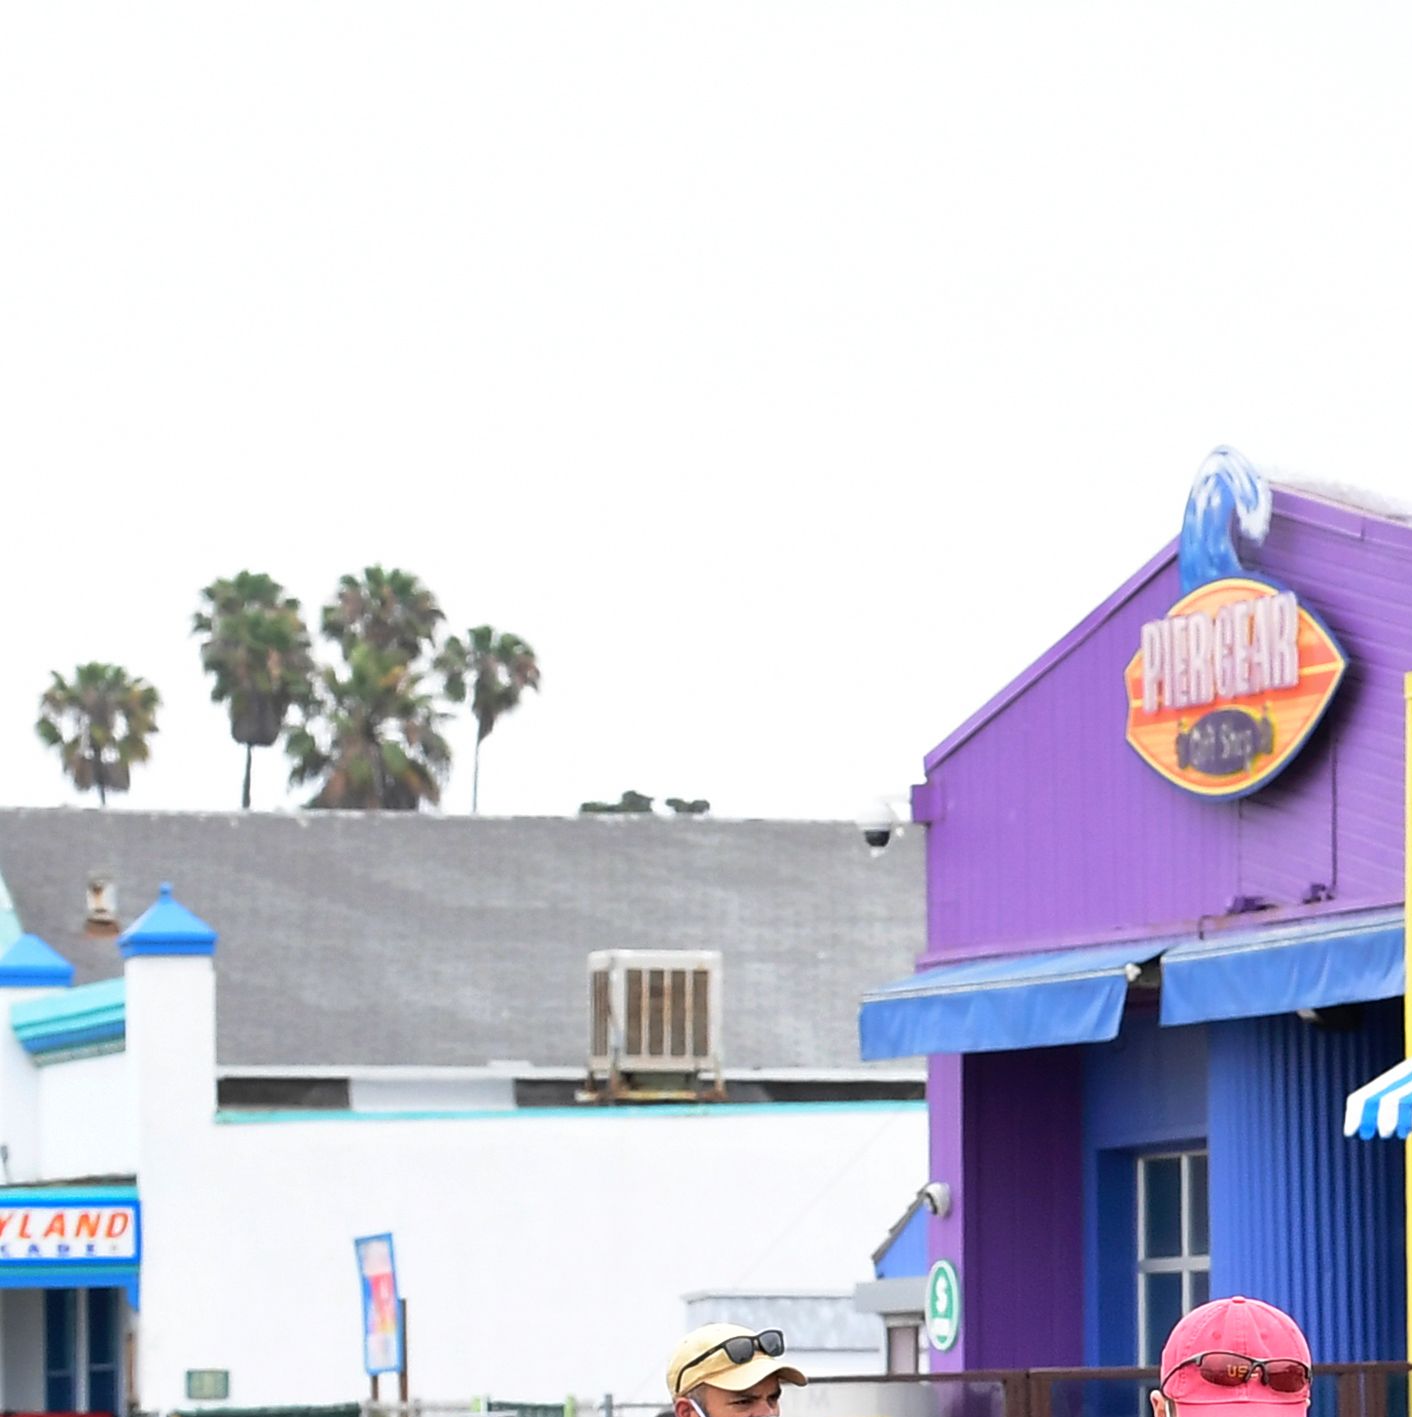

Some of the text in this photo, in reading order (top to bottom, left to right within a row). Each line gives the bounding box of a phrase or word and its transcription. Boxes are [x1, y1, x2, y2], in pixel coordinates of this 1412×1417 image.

[1141, 590, 1300, 716] PIER GEAR
[1226, 1364, 1259, 1377] US
